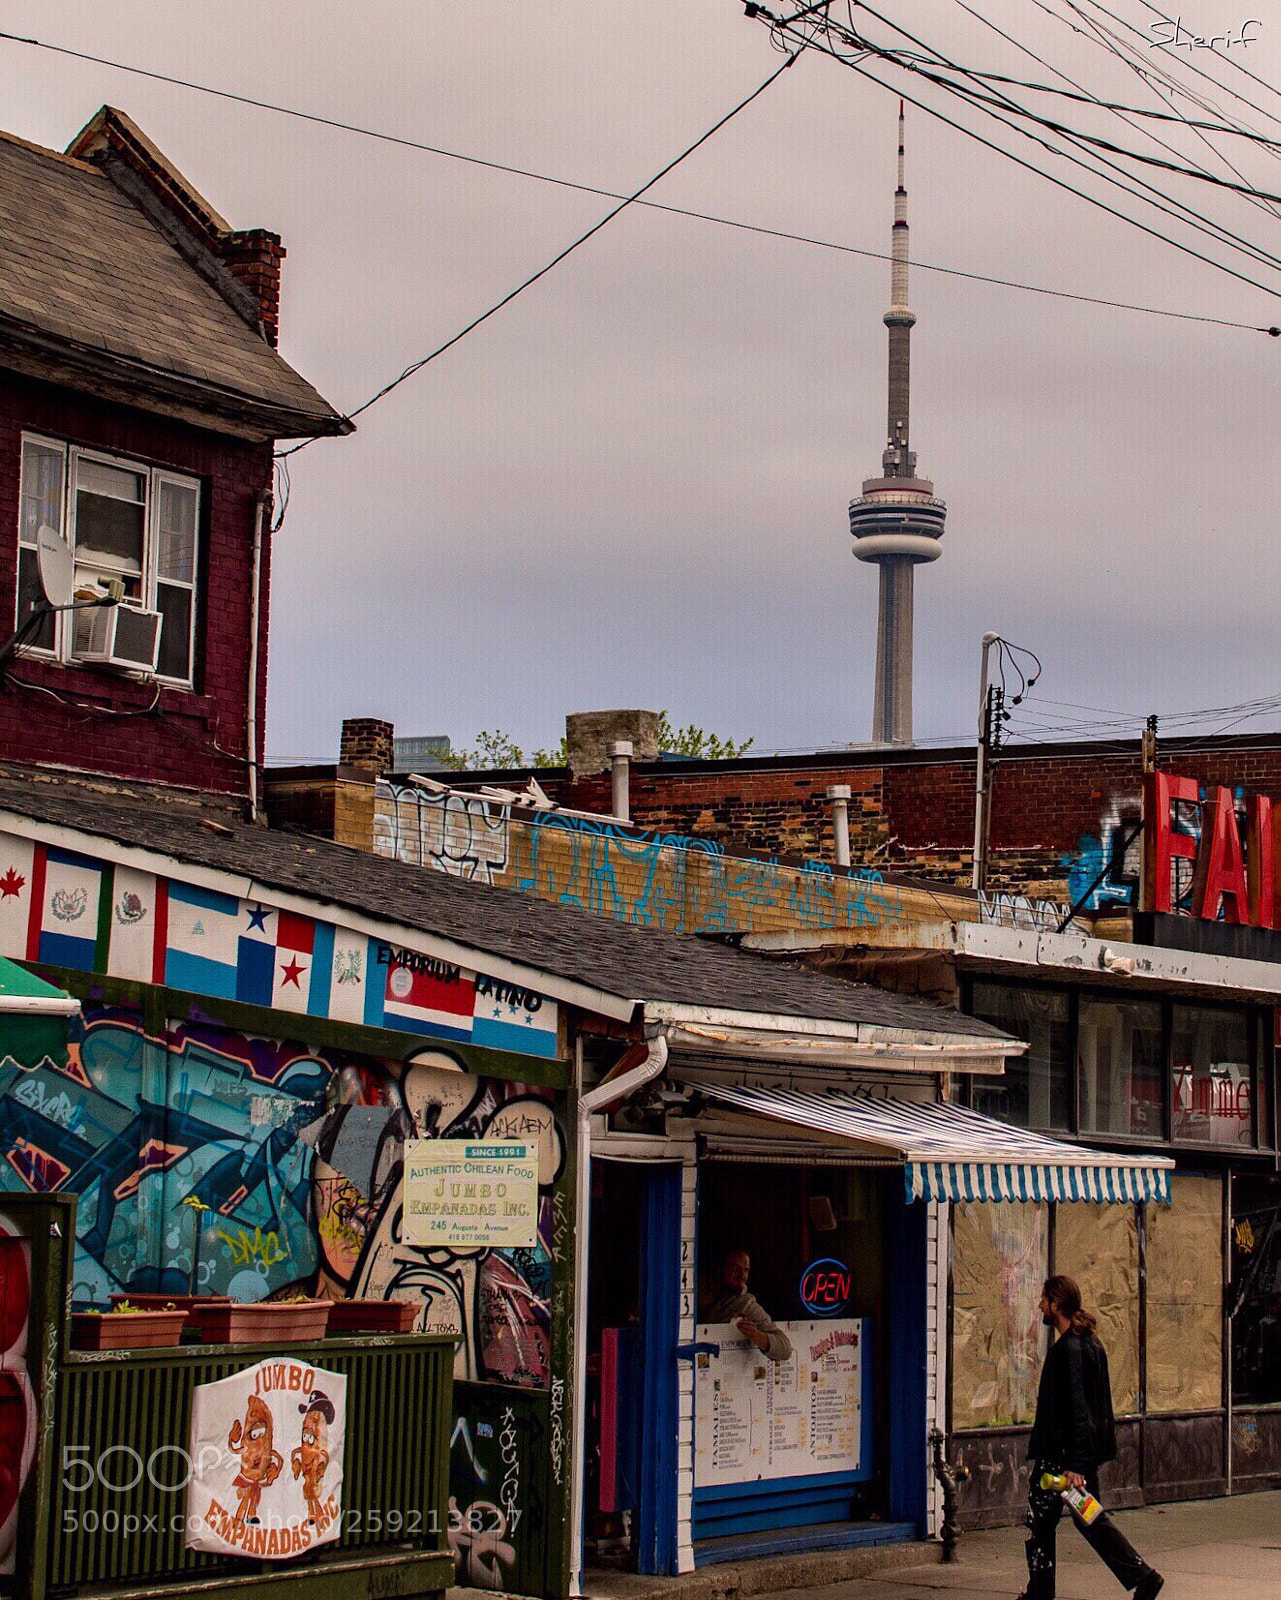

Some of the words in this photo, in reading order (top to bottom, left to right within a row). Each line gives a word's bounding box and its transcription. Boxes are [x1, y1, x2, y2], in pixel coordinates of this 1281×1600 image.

[377, 946, 461, 985] EMPORIUM
[473, 972, 543, 1013] LATINO
[471, 1148, 496, 1157] SINCE
[500, 1147, 521, 1156] 1991
[410, 1164, 461, 1179] AUTHENTIC
[464, 1162, 504, 1175] CHILEAN
[506, 1164, 534, 1179] FOOD
[433, 1178, 507, 1198] JUMBO
[410, 1200, 497, 1216] EMPANADAS
[502, 1201, 530, 1217] INC.
[431, 1220, 447, 1230] 245
[452, 1223, 478, 1232] Augusta
[484, 1223, 509, 1231] Avenue
[217, 1227, 287, 1267] DMC
[802, 1273, 851, 1302] OPEN
[255, 1363, 315, 1396] JUMBO
[204, 1498, 313, 1556] EMPANADAS
